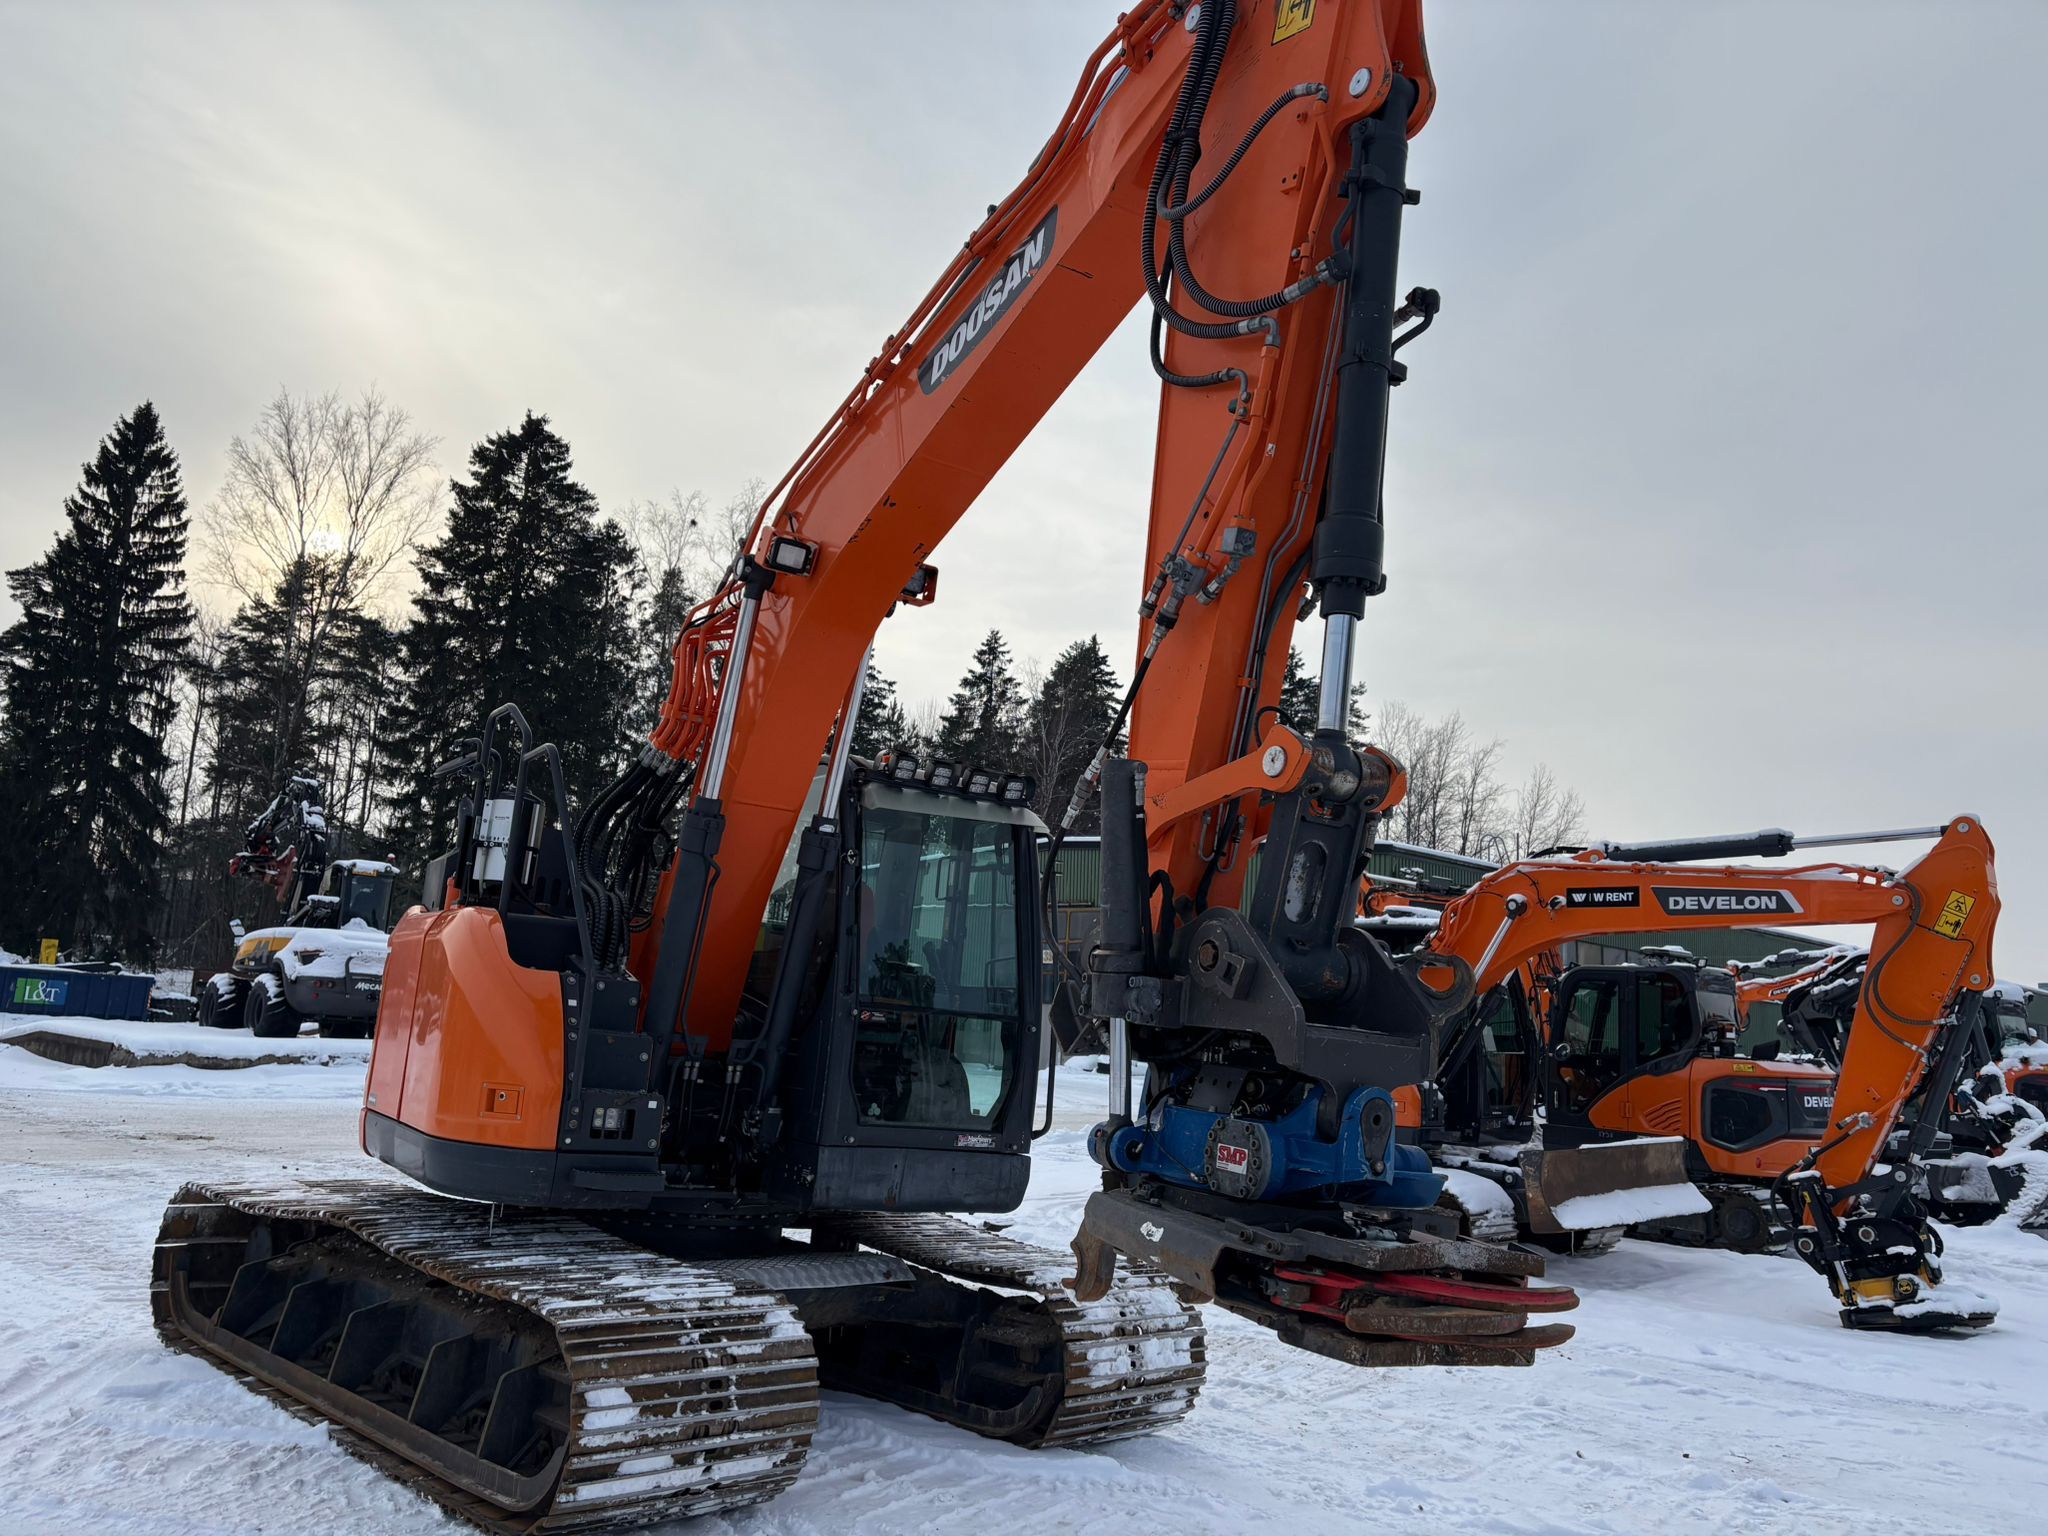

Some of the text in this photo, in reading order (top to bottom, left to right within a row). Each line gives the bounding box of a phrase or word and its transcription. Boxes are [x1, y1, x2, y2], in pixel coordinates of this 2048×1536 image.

[930, 227, 1045, 385] DOOSAN
[1593, 892, 1605, 902] W
[1606, 891, 1634, 902] RENT
[1668, 896, 1777, 910] DEVELON
[24, 980, 60, 1002] L&T
[1218, 1145, 1247, 1166] SMP
